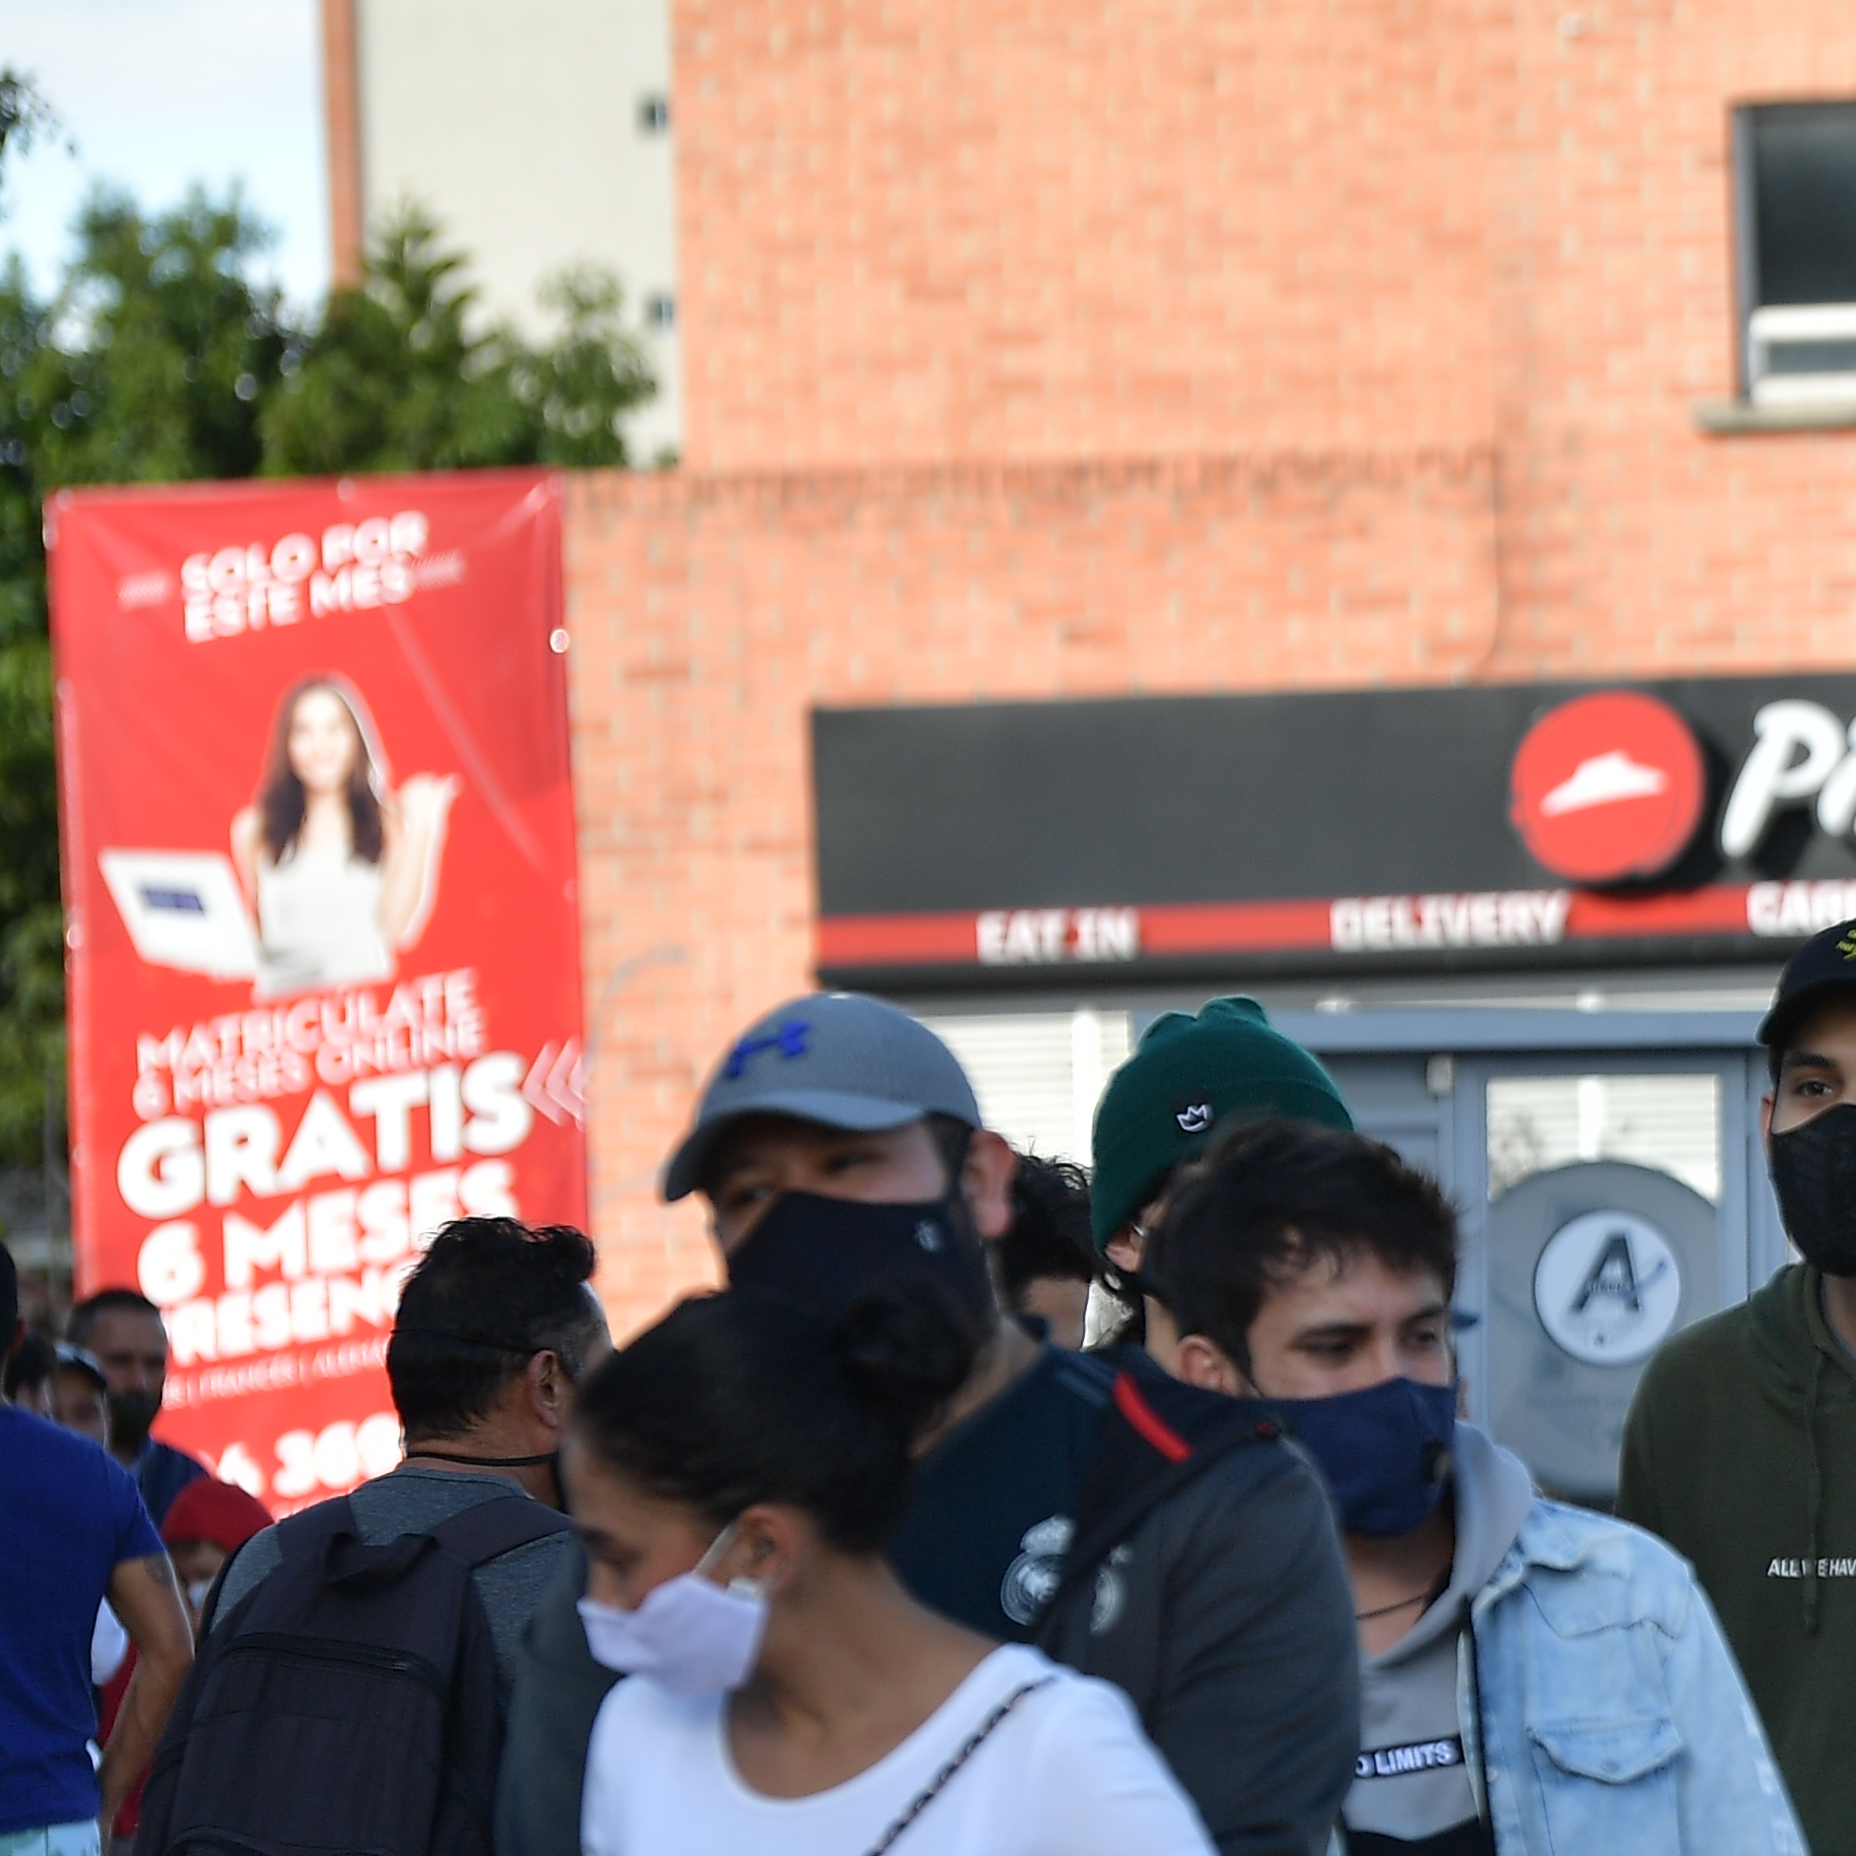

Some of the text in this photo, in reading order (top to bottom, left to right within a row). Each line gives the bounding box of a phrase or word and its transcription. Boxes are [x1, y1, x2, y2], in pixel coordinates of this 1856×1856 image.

[181, 510, 429, 592] SOLO POR
[182, 557, 415, 644] ESTE MES
[975, 908, 1068, 966] EAT
[1074, 906, 1138, 962] IN
[1330, 888, 1567, 952] DELIVERY
[117, 1050, 534, 1220] GRATIS
[138, 1159, 519, 1307] 6 MESES
[1570, 1233, 1640, 1313] A
[1767, 1557, 1800, 1578] ALL
[1374, 1739, 1459, 1776] LIMITS
